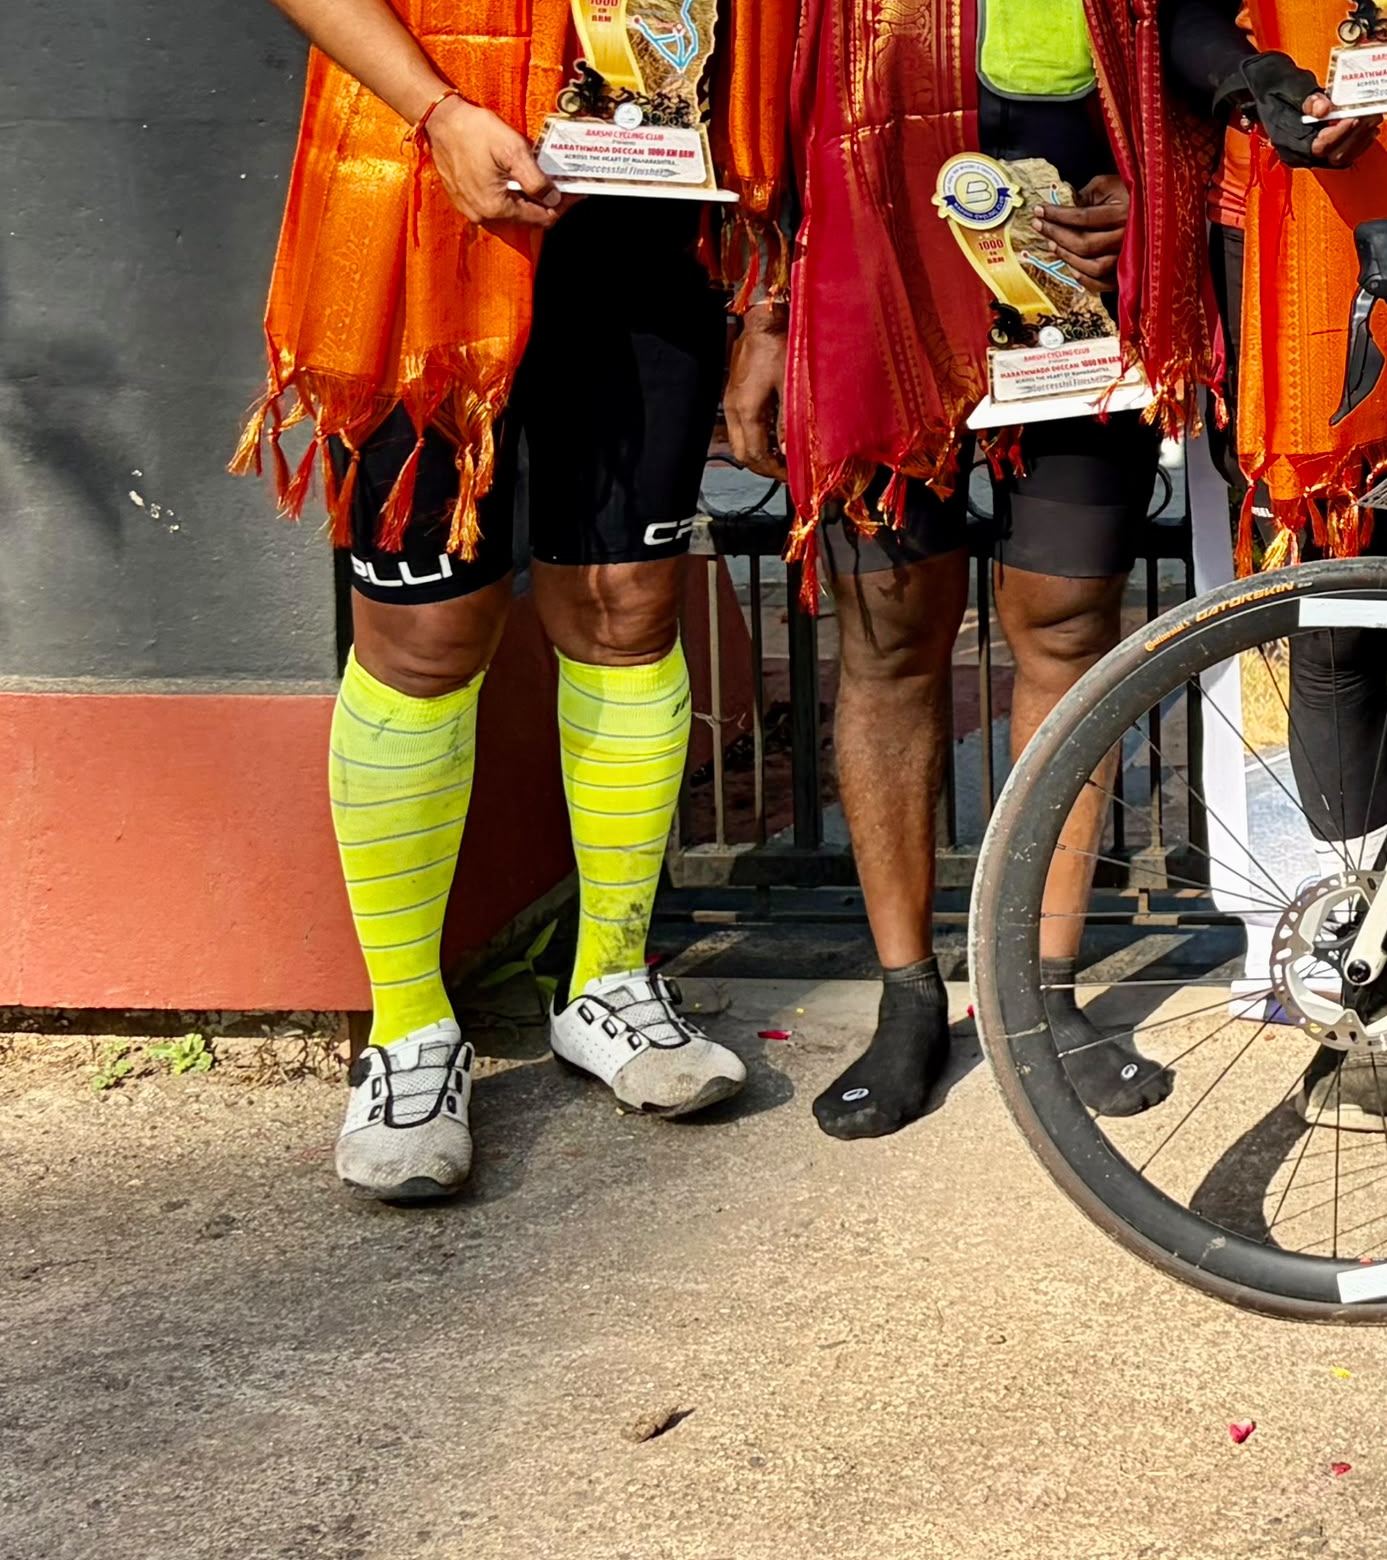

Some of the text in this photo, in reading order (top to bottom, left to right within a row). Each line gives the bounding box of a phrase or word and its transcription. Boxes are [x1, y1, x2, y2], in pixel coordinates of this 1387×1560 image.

[612, 147, 644, 155] DECCAN
[978, 239, 1004, 251] 1000
[1196, 581, 1295, 622] GATORSKIN
